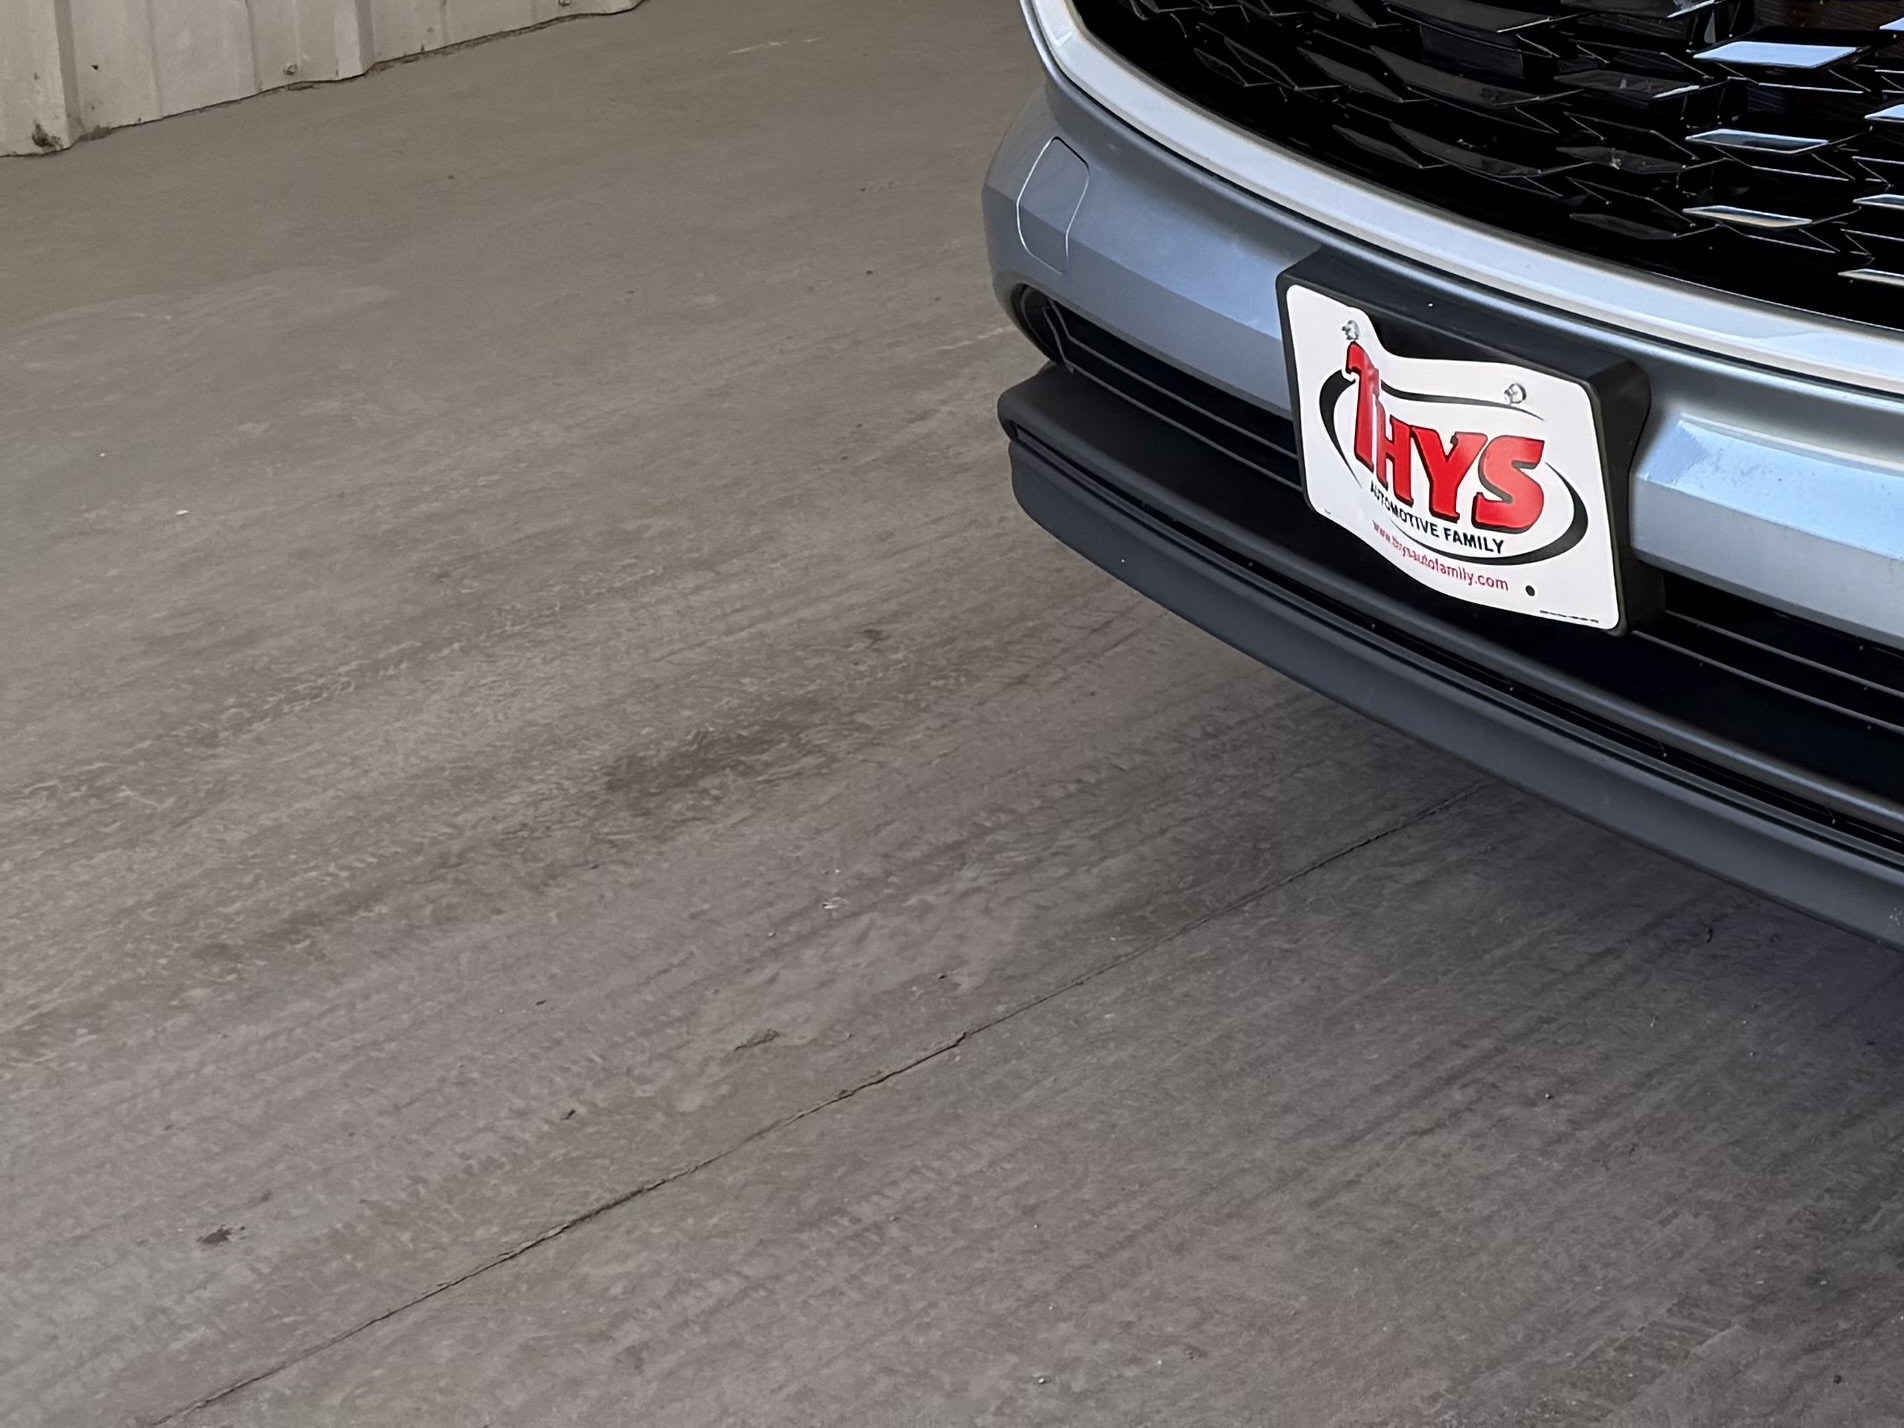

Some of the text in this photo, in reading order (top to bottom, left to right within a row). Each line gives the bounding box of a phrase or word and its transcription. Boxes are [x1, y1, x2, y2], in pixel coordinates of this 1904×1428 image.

[1345, 341, 1546, 534] THYS
[1370, 480, 1504, 554] AUTOMOTIVE FAMILY
